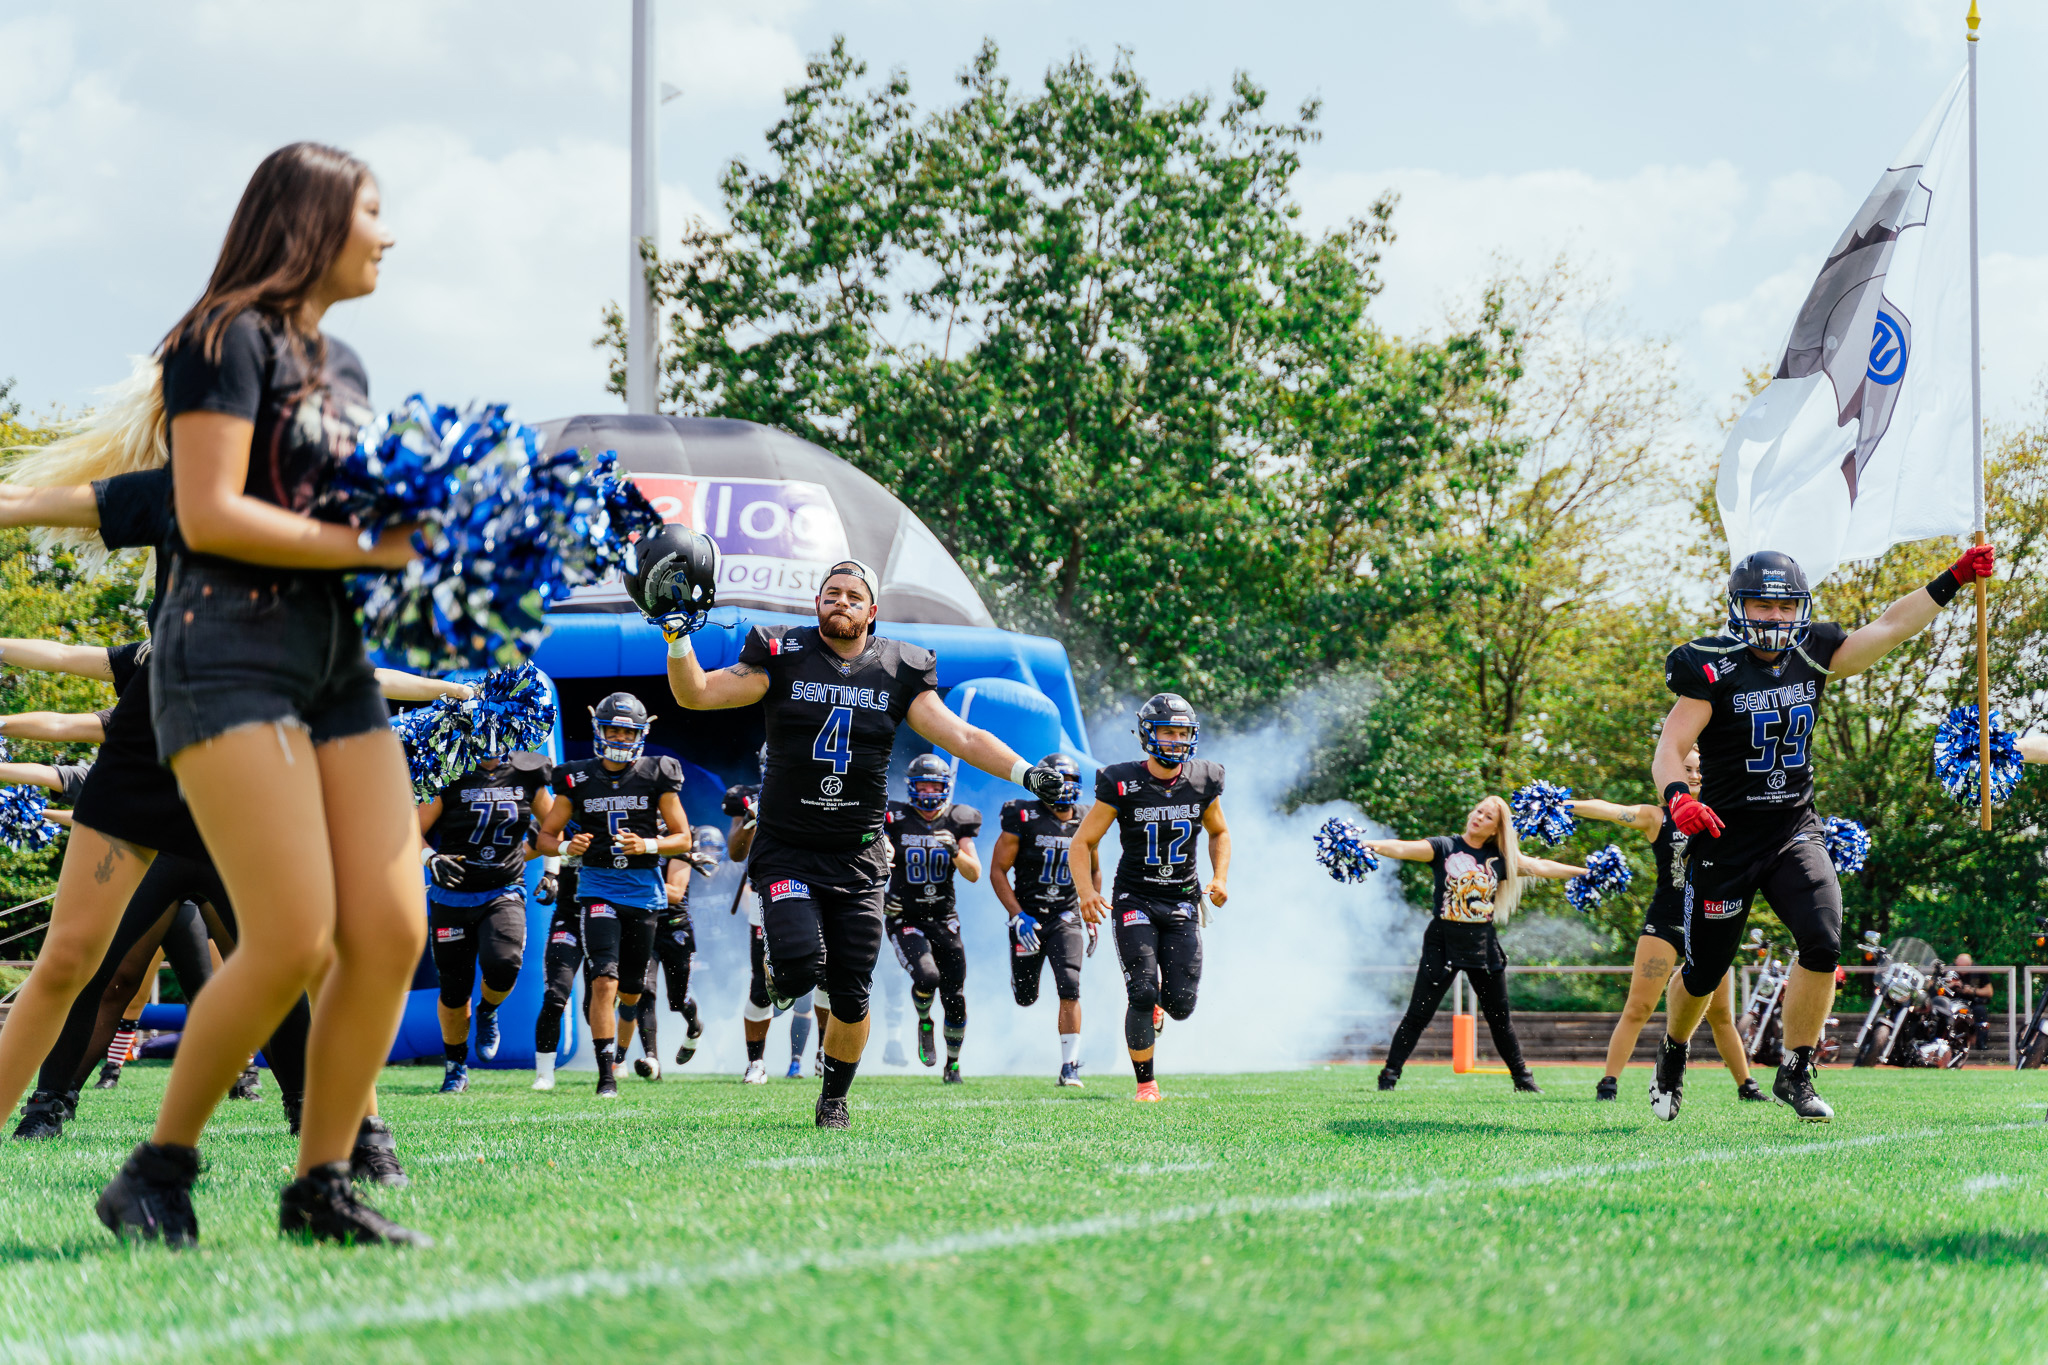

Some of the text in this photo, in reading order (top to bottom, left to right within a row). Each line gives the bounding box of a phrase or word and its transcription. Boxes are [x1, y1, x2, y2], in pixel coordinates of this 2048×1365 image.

[717, 559, 818, 590] logist
[791, 680, 889, 711] SENTINELS
[1733, 680, 1816, 713] SENTINELS
[812, 706, 853, 774] 4
[1745, 704, 1815, 772] 59
[460, 786, 525, 803] SENTINELS
[583, 796, 649, 812] SENTINELS
[468, 801, 519, 845] 72
[1134, 803, 1201, 822] SENTINELS
[607, 810, 631, 855] 5
[1143, 819, 1193, 865] 12
[905, 846, 950, 884] 80
